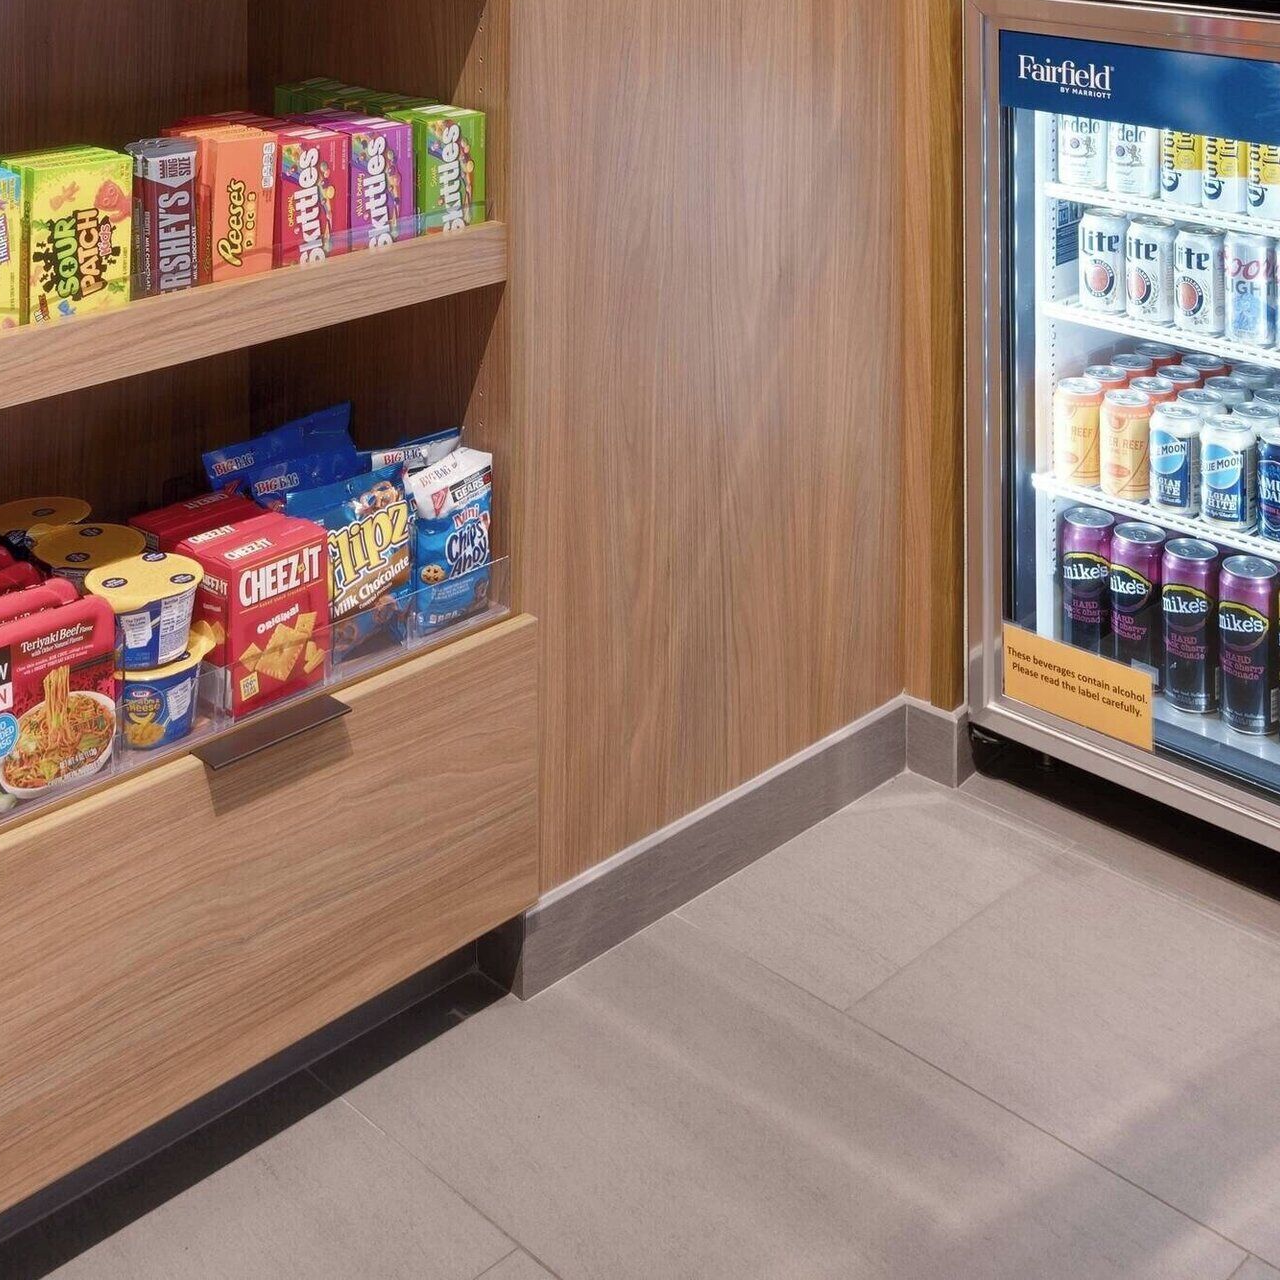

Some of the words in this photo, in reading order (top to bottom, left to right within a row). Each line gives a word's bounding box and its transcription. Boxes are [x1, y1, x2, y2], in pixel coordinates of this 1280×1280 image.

[1017, 54, 1111, 91] Fairfield
[1060, 86, 1069, 94] BY
[1072, 88, 1111, 99] MARRIOTT
[166, 157, 178, 178] KING
[178, 156, 191, 178] SIZE
[216, 178, 247, 267] Reese's
[1081, 226, 1120, 254] Lite
[53, 217, 79, 298] SOUR
[77, 208, 108, 297] PATCH
[360, 555, 410, 601] Chocolate
[1007, 646, 1031, 662] These
[1033, 655, 1076, 678] beverages
[1078, 673, 1110, 691] contain
[1112, 686, 1148, 704] alcohol.
[1012, 661, 1039, 679] Please
[1040, 674, 1060, 687] read
[1061, 680, 1077, 693] the
[1078, 685, 1100, 701] label
[1101, 695, 1143, 718] carefully.
